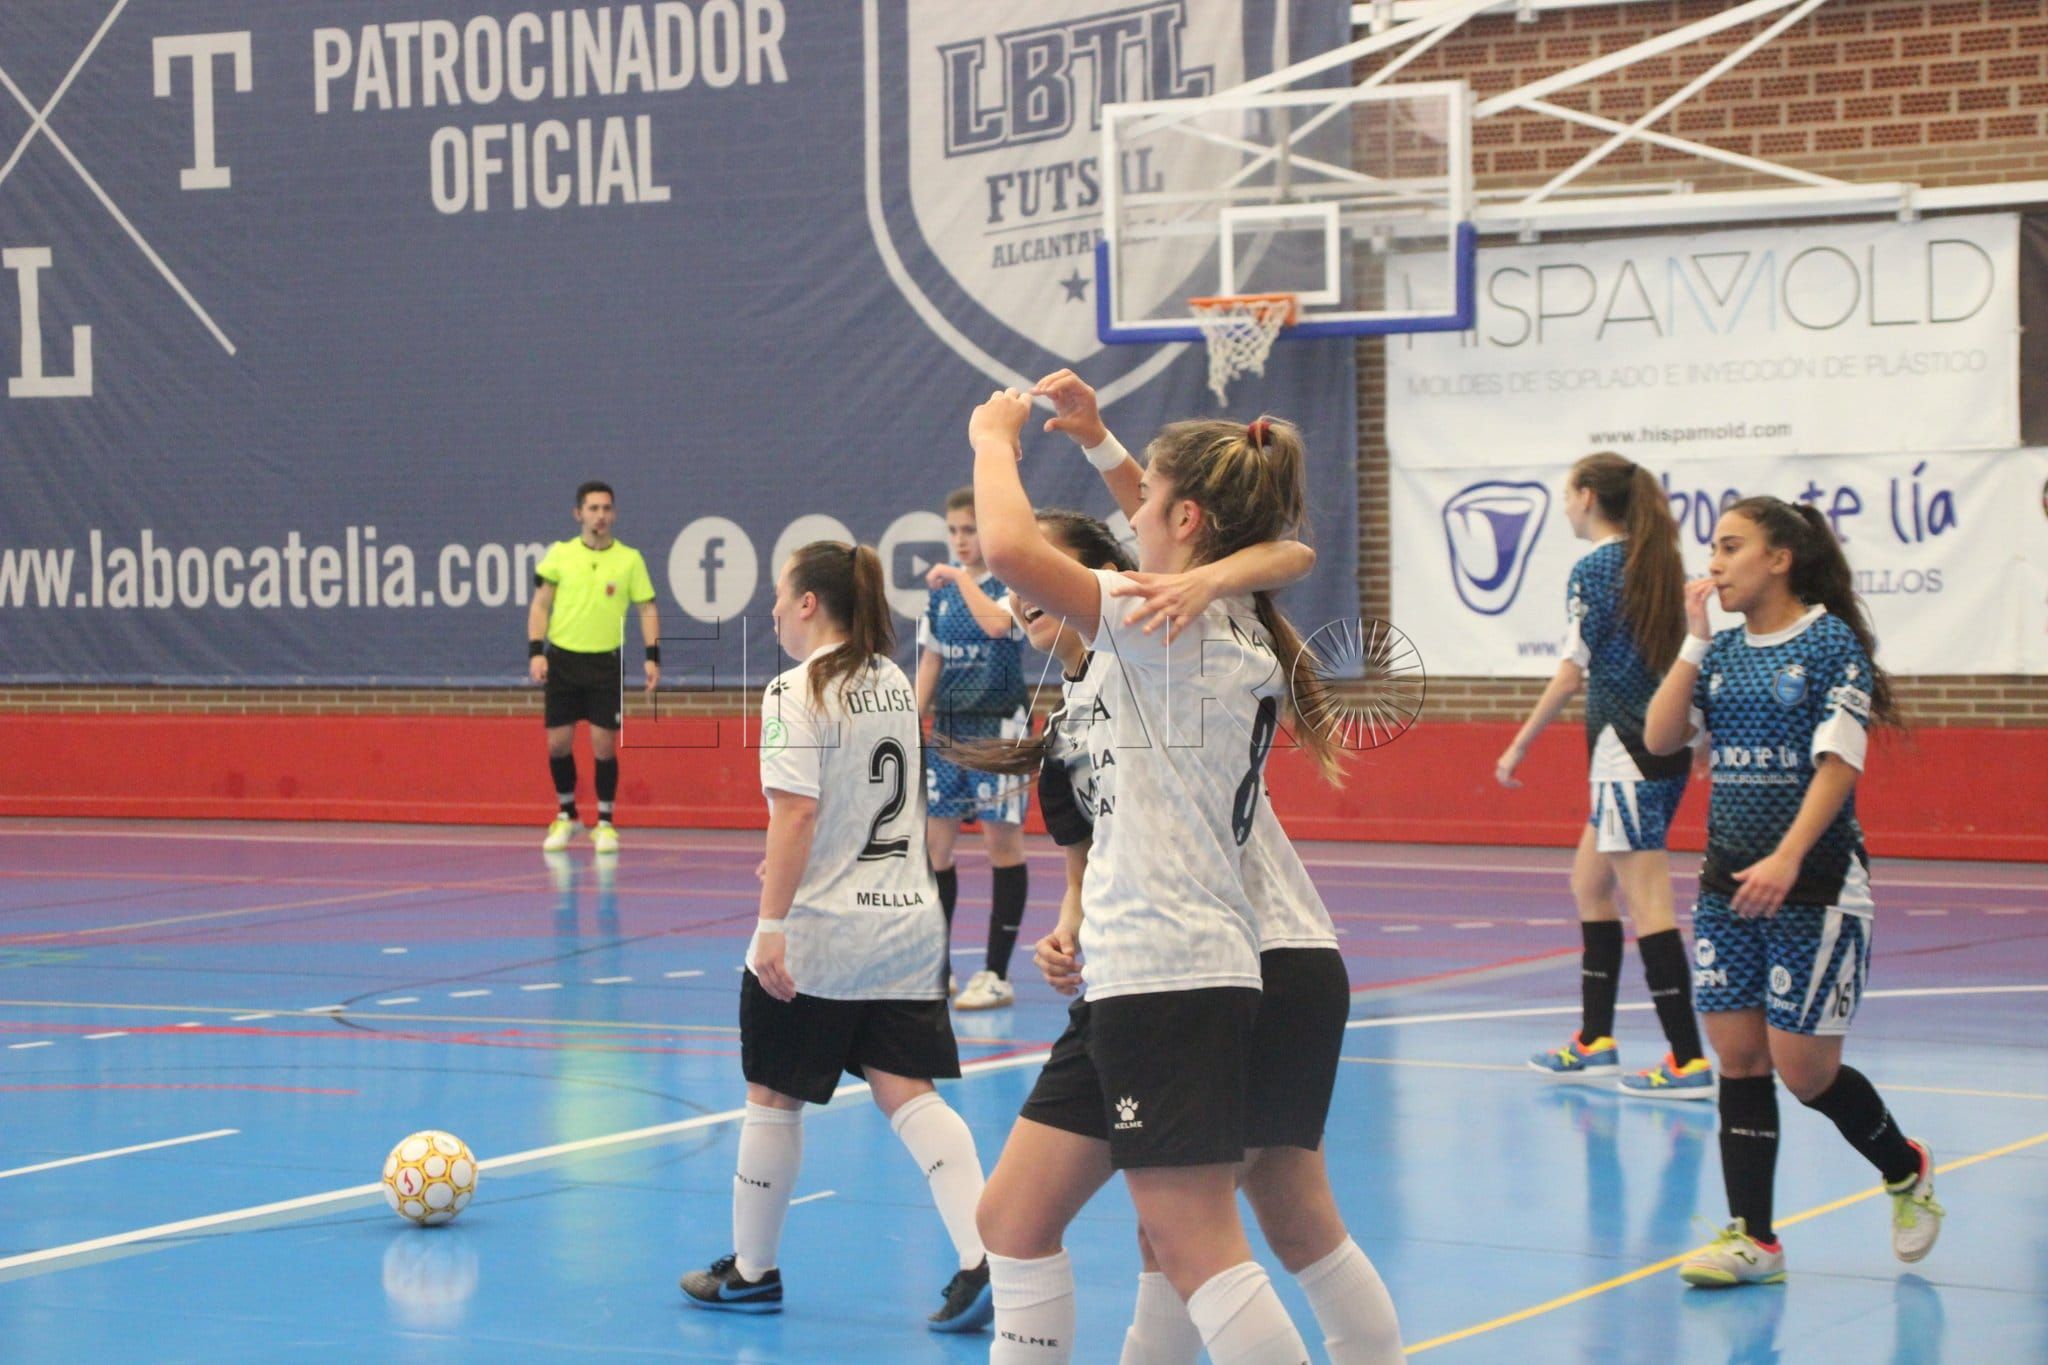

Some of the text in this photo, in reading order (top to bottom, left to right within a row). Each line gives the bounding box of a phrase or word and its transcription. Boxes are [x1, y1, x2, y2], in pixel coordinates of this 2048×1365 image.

[312, 0, 789, 114] PATROCINADOR
[936, 0, 1216, 159] LBTL
[152, 31, 252, 190] T
[430, 115, 671, 214] OFICIAL
[985, 146, 1164, 225] FUTSL
[2, 247, 93, 398] L
[1407, 372, 1503, 397] MOLDES
[1509, 369, 1540, 394] DE
[1546, 364, 1659, 393] SOPLADO
[1664, 362, 1681, 387] E
[1824, 354, 1857, 380] DE
[1864, 347, 1988, 378] PLÁSTICO
[1589, 421, 1794, 445] www.hispamold.com
[1890, 461, 1957, 544] lía
[857, 736, 911, 862] 2
[1231, 695, 1278, 847] 8
[857, 891, 924, 908] MELILLA
[1115, 1120, 1143, 1130] KELME
[1001, 1330, 1058, 1347] KELME
